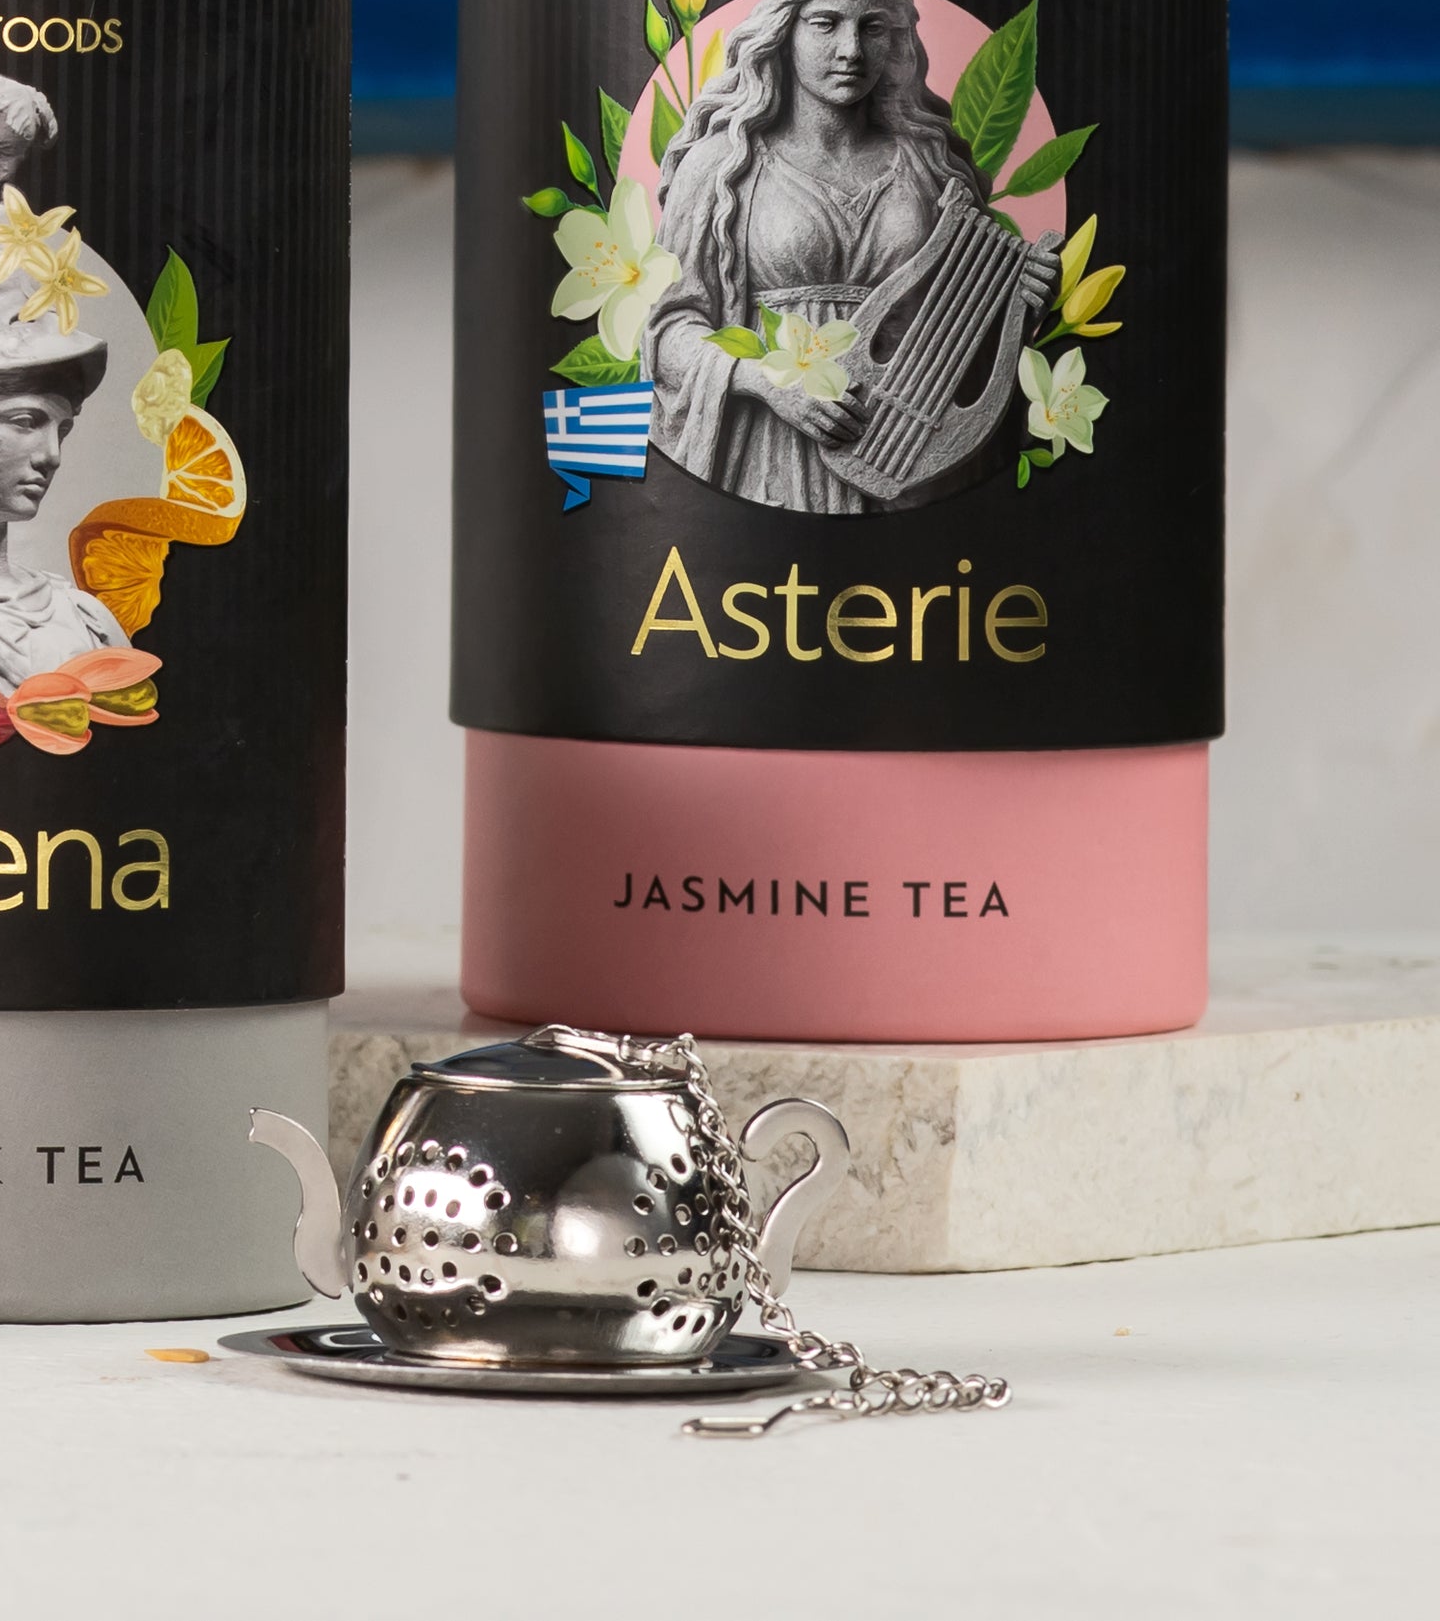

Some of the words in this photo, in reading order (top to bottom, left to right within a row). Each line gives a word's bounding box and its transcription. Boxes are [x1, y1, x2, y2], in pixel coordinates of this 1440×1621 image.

[630, 545, 1048, 664] Asterie
[614, 873, 868, 916] JASMINE
[903, 882, 1009, 917] TEA
[37, 1146, 145, 1183] TEA
